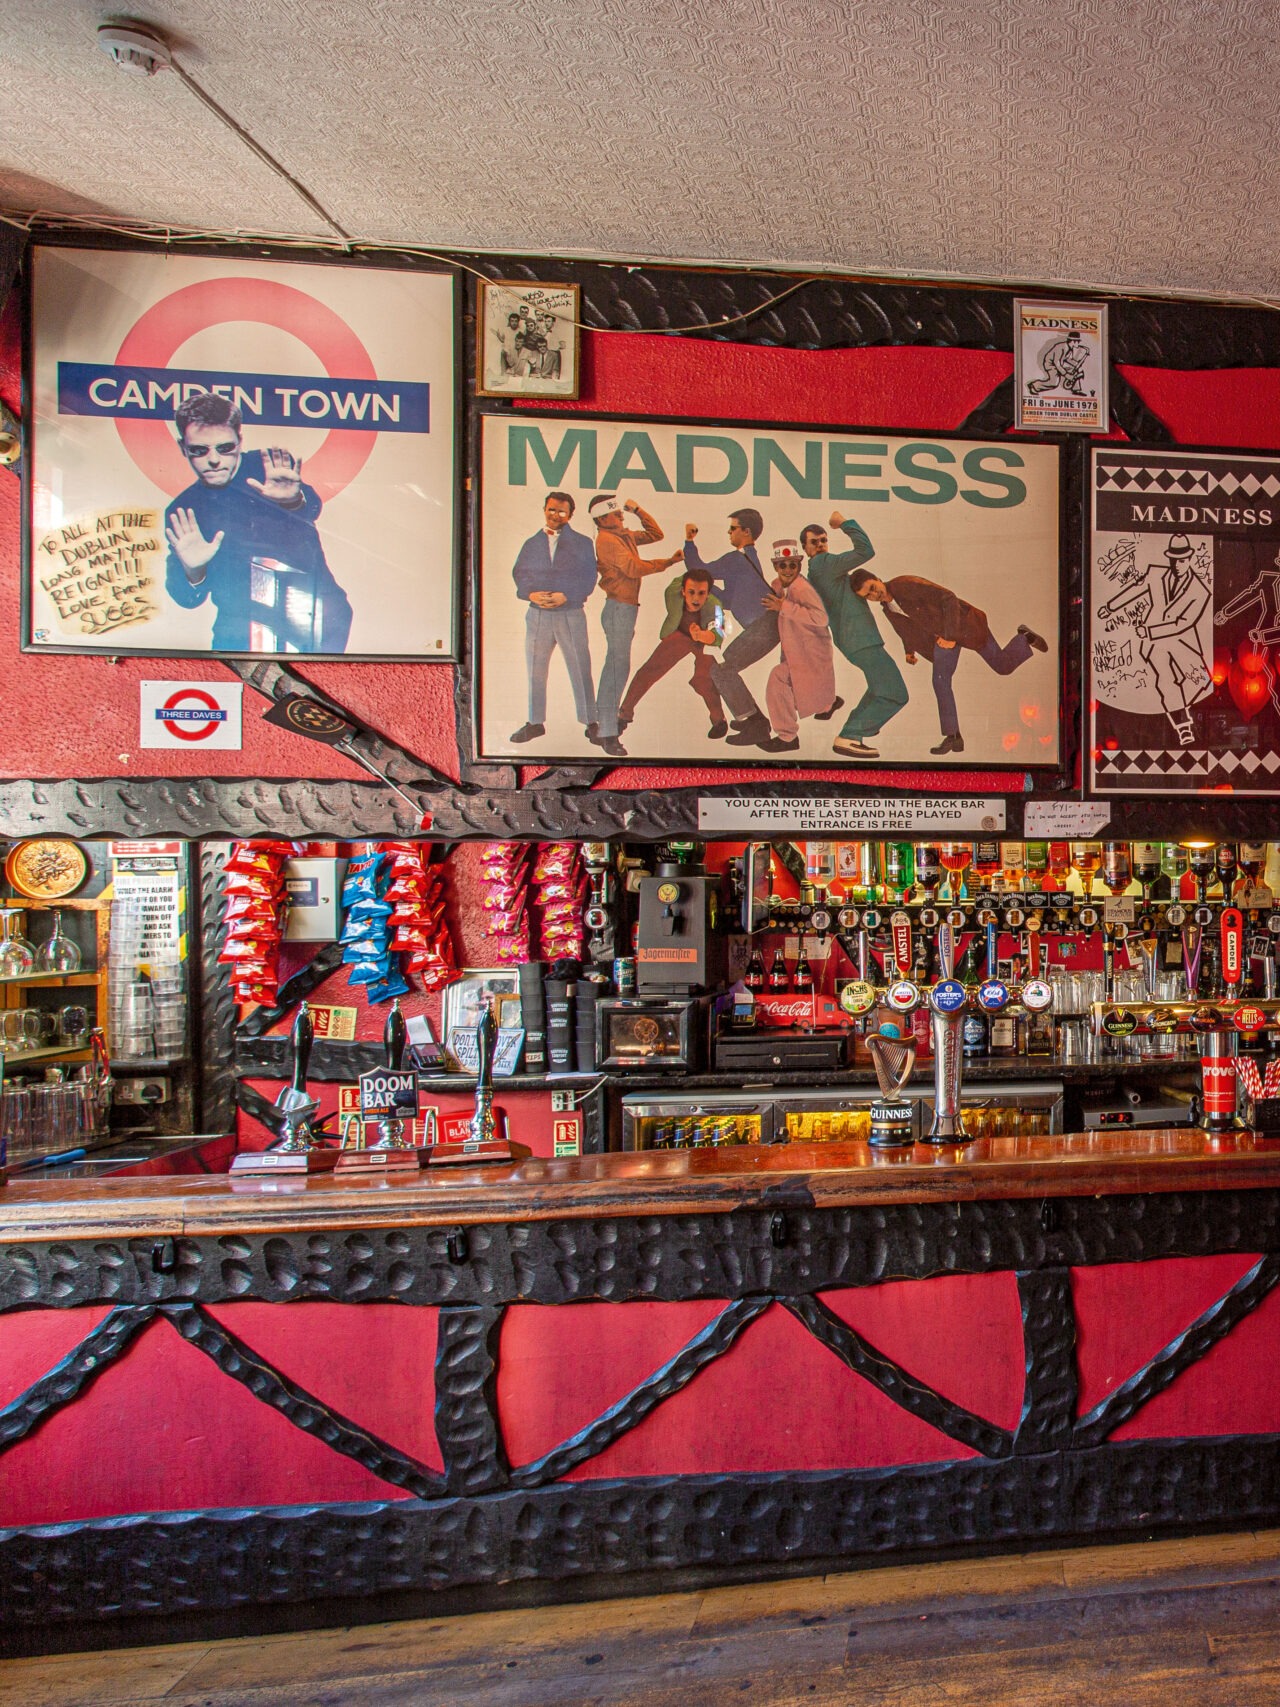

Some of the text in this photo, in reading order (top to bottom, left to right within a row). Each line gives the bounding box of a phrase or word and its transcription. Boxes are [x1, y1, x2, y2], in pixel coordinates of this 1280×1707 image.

[1022, 318, 1098, 330] MADNESS
[275, 387, 400, 423] TOWN
[507, 425, 1027, 509] MADNESS
[1131, 504, 1272, 527] MADNESS
[62, 524, 89, 543] ALL
[122, 513, 154, 528] THE
[59, 530, 130, 566] DUBLIN
[40, 566, 81, 591] LONG
[161, 711, 222, 719] THREE DAVES
[750, 810, 789, 818] AFTER
[819, 810, 849, 818] LAST
[853, 810, 885, 818] BAND
[801, 820, 865, 828] ENTRANCE
[898, 927, 909, 963] AMSTEL
[1241, 1012, 1258, 1024] HELLS
[363, 1075, 415, 1093] DOOM
[364, 1092, 397, 1108] BAR
[870, 1107, 913, 1119] GUINNESS
